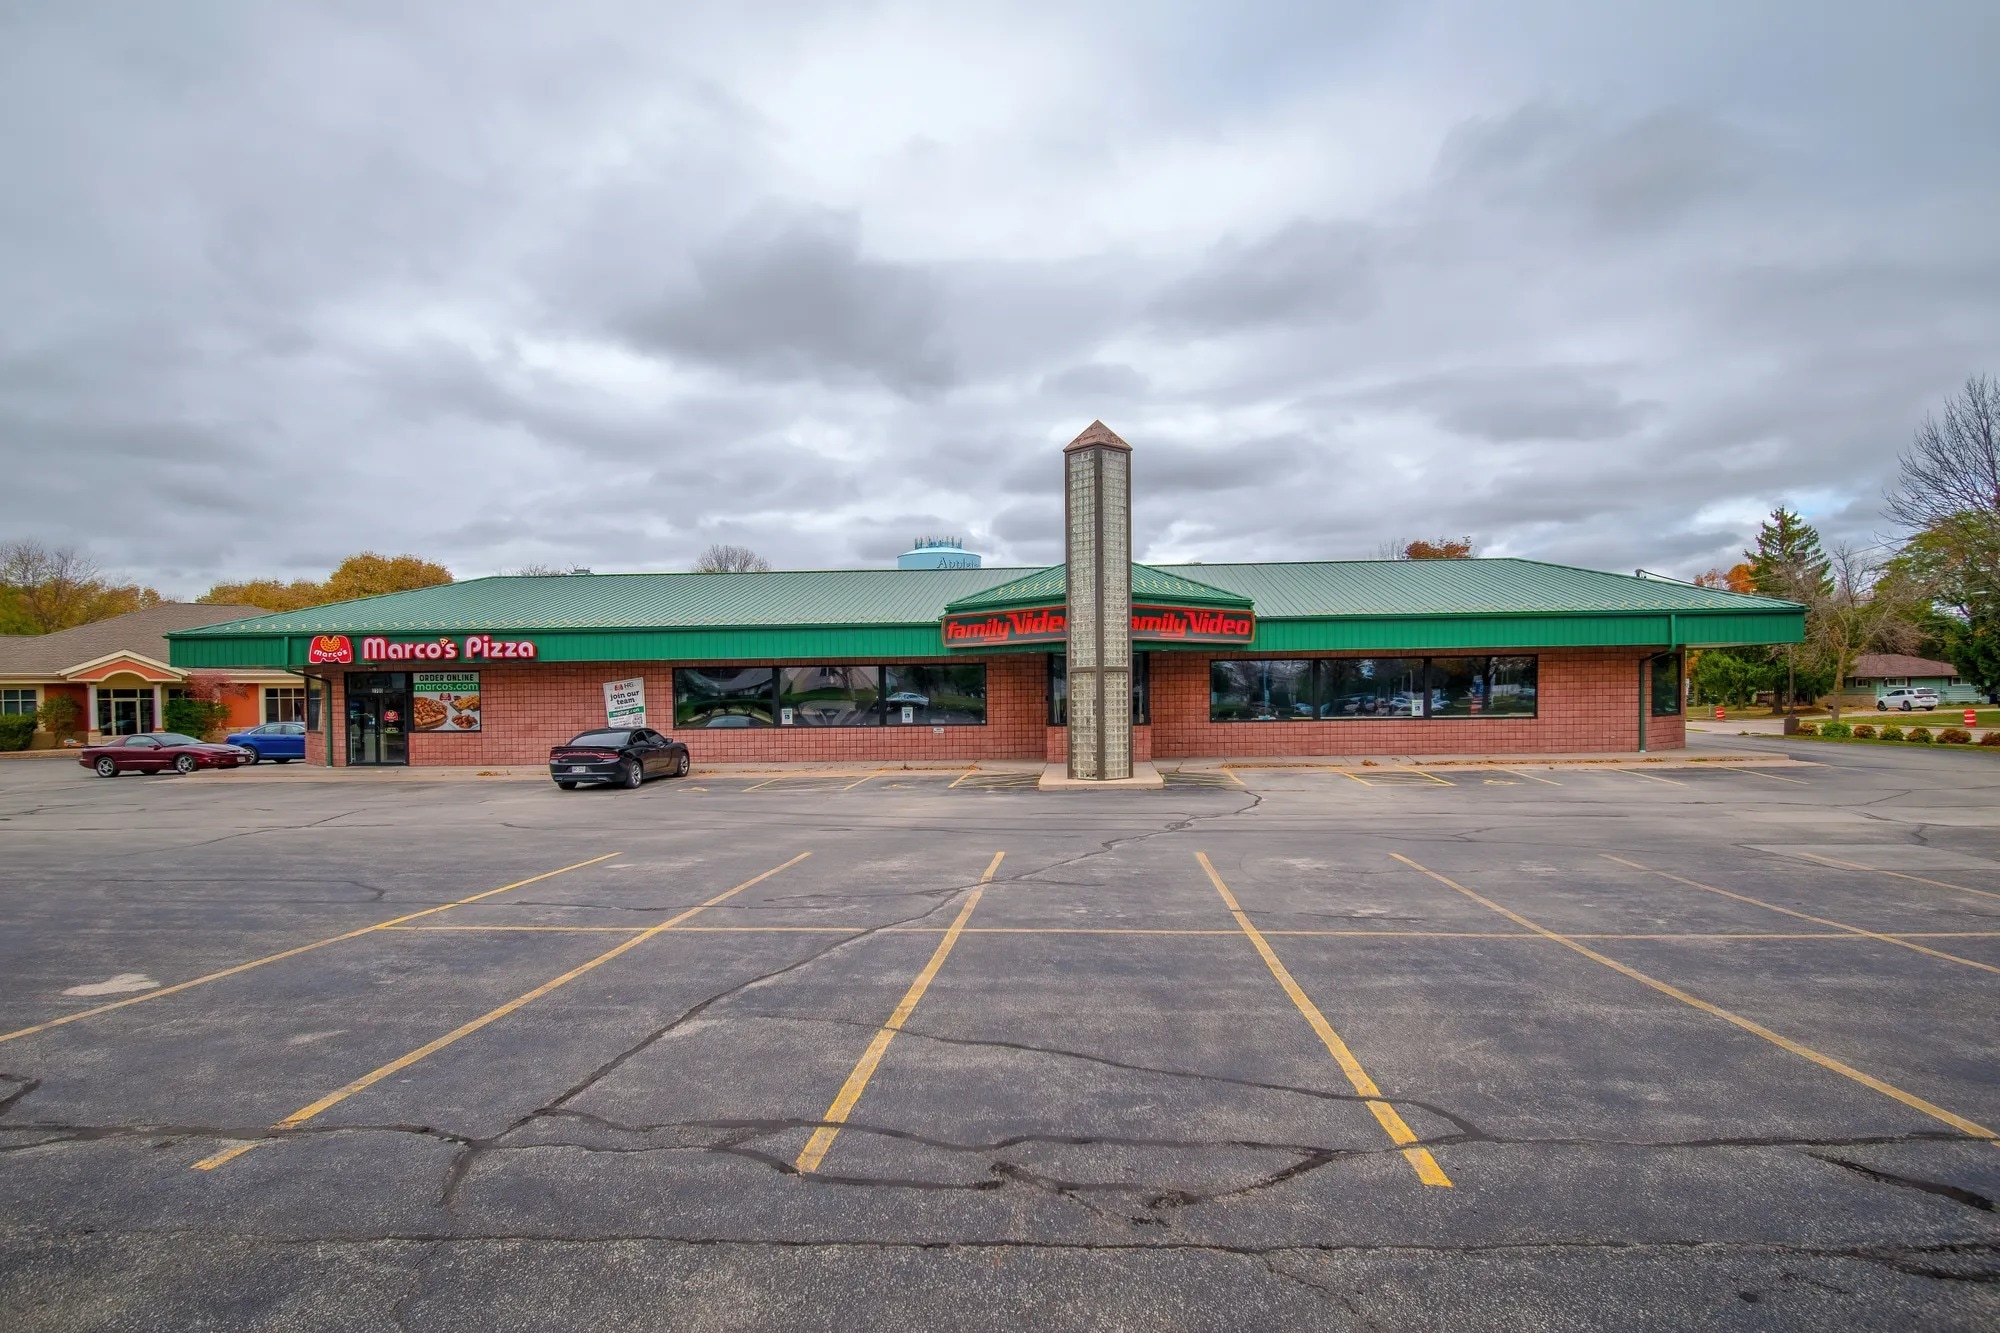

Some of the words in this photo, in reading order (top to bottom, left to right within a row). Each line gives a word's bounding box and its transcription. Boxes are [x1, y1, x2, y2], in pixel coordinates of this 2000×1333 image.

[1131, 613, 1188, 638] amily
[1183, 611, 1251, 636] Video
[362, 636, 458, 661] Marco's
[464, 634, 537, 660] Pizza
[419, 674, 444, 682] ORDER
[415, 683, 479, 691] marcos.com
[626, 690, 640, 698] our
[616, 697, 636, 706] team
